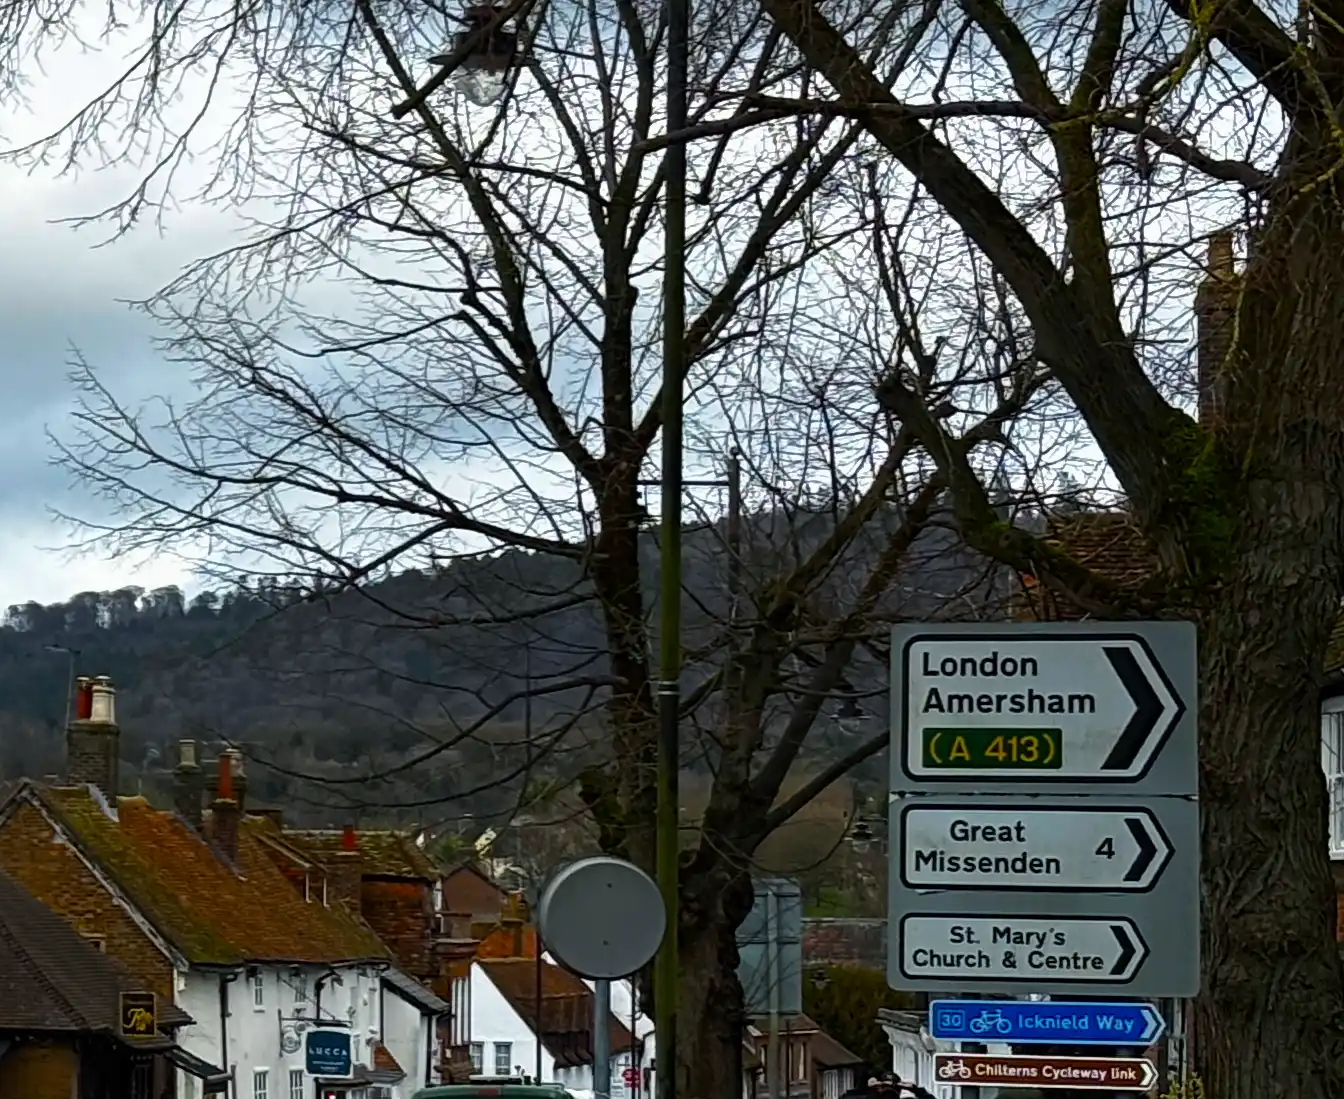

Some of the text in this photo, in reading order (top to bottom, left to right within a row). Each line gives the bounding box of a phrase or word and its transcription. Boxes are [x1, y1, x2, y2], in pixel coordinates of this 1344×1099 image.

[922, 651, 1038, 677] London
[922, 687, 1096, 714] Amersham
[949, 819, 1026, 842] Great
[1094, 837, 1116, 860] 4
[914, 849, 1061, 874] Missenden
[949, 925, 1066, 949] St. Mary's
[912, 948, 1105, 970] Church & Centre
[940, 1013, 1135, 1034] 30 Icknield Way
[308, 1046, 348, 1056] LUCCA
[974, 1062, 1038, 1077] Chilterns
[1041, 1065, 1108, 1082] Cycleway
